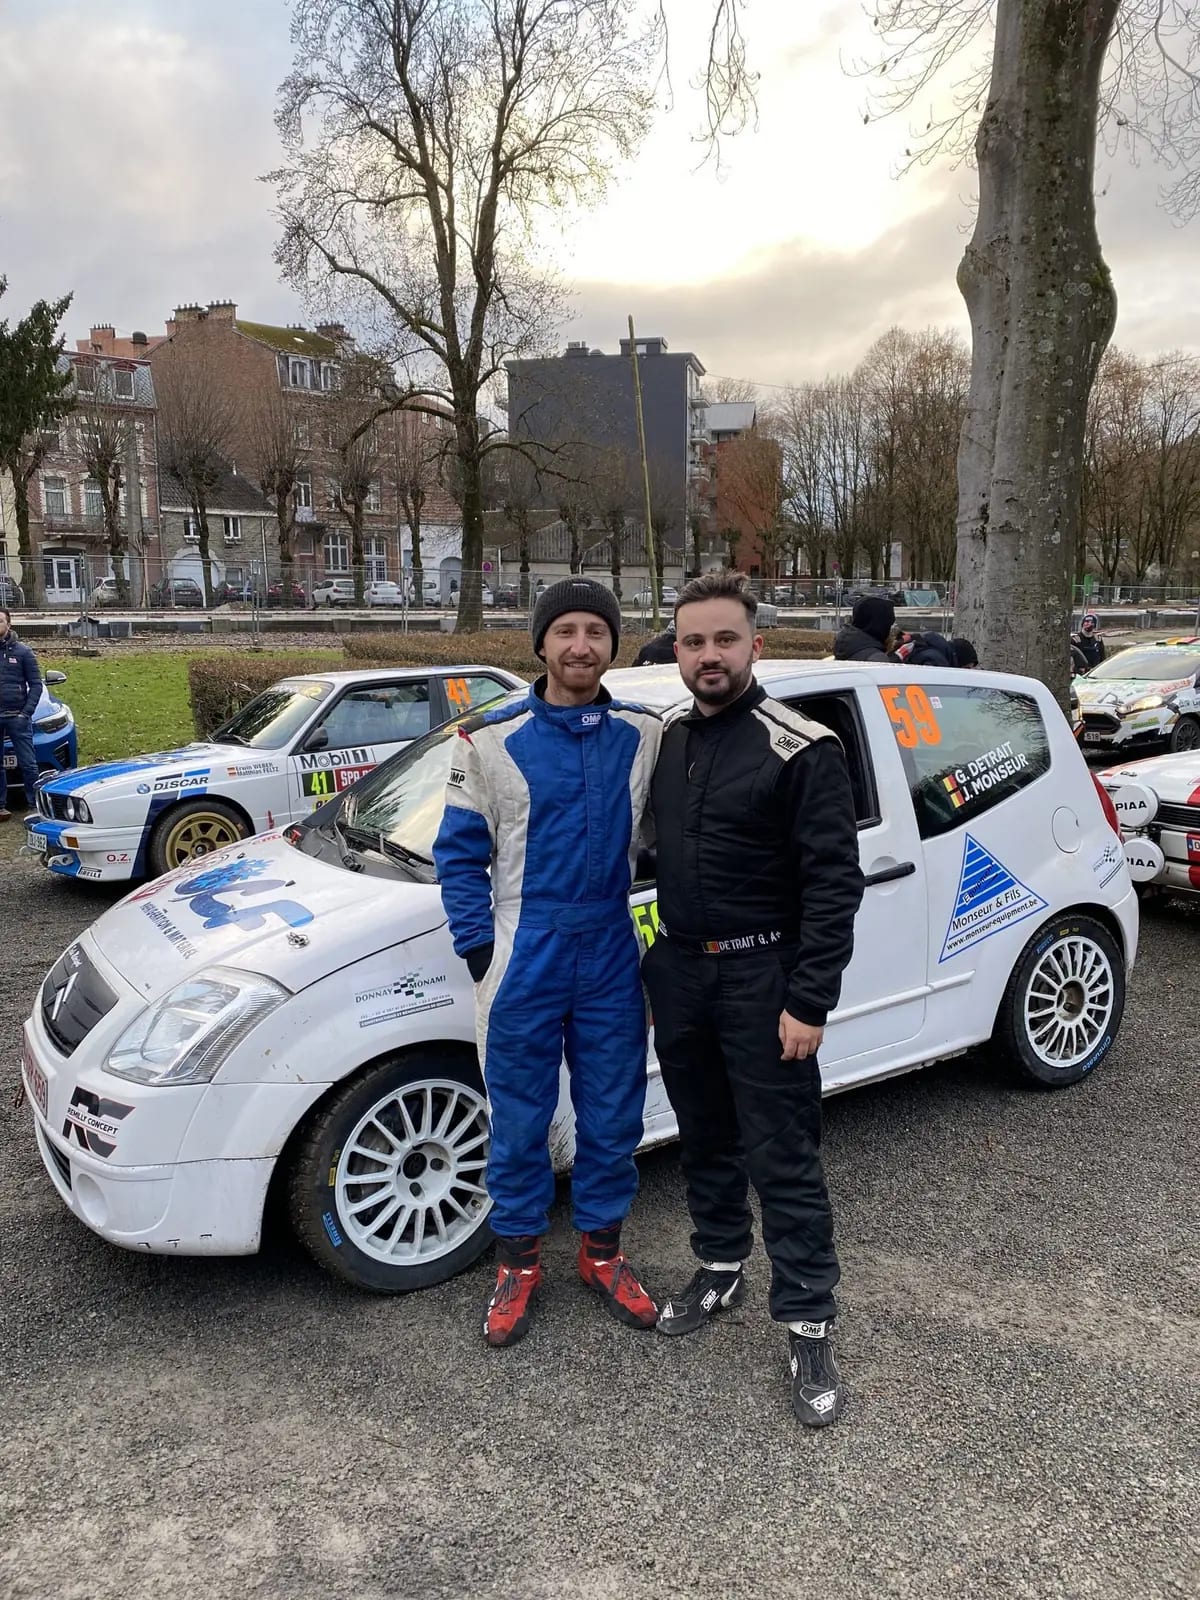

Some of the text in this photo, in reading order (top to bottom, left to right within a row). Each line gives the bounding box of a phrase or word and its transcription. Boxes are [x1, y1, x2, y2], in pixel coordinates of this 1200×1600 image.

[581, 714, 602, 724] OMP
[879, 684, 942, 748] 59
[777, 736, 800, 749] OMP
[299, 749, 366, 769] Mobil 1
[955, 741, 1014, 784] G. DETRAIT
[153, 776, 209, 791] DISCAR
[311, 771, 328, 795] 41
[963, 753, 1029, 802] J. MONSEUR
[1115, 800, 1148, 811] PIAA
[951, 888, 1022, 932] Monseur & Fils
[946, 898, 1039, 951] www.monseur-equipment.be
[718, 935, 756, 951] DETRAIT
[757, 933, 769, 945] G.
[355, 988, 393, 1003] DONNAY
[408, 974, 447, 990] MONAMI
[87, 1117, 119, 1135] CONCEPT
[703, 1290, 718, 1310] OMP
[801, 1324, 822, 1335] OMP
[813, 1393, 836, 1411] OMP
